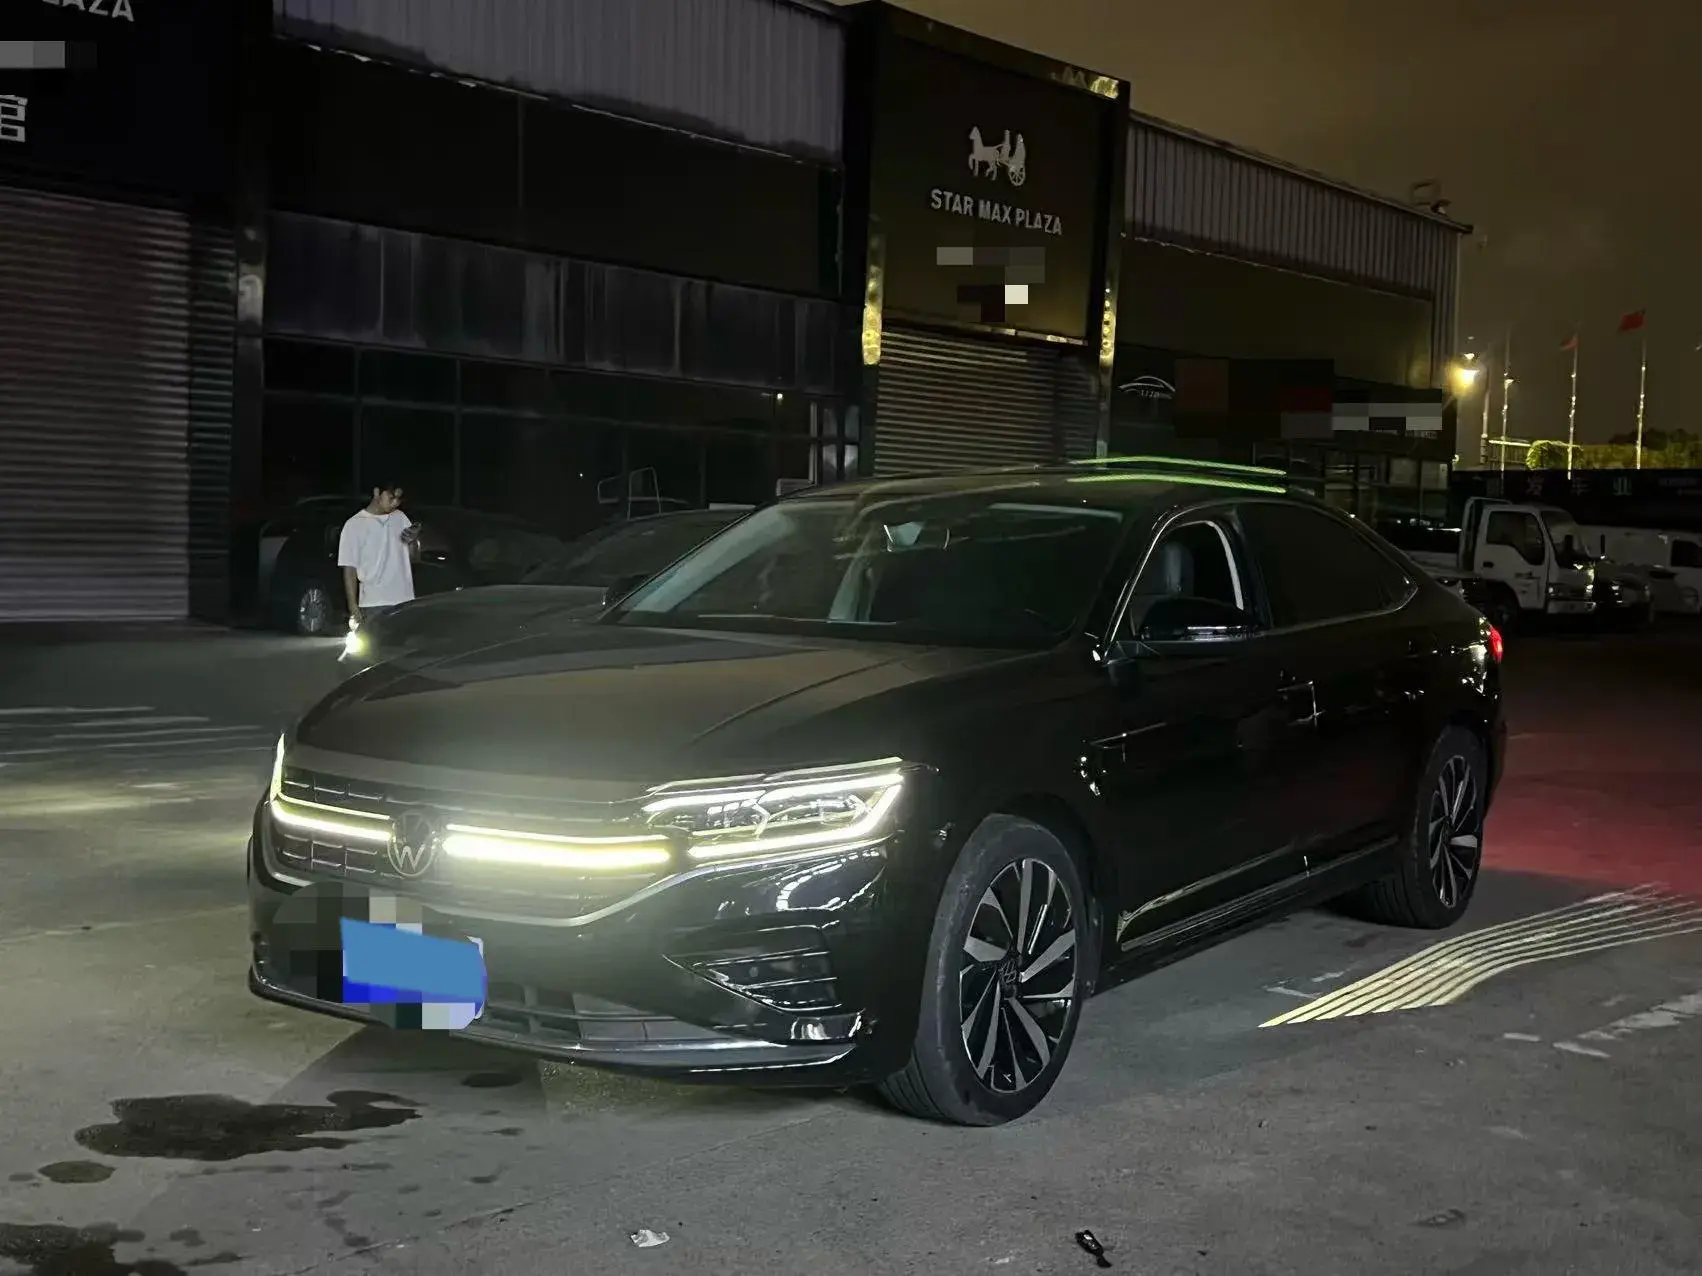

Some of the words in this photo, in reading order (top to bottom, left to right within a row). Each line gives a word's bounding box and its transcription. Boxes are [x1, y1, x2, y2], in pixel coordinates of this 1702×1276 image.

[931, 188, 974, 216] STAR
[978, 200, 1012, 225] MAX
[1014, 208, 1062, 236] PLAZA
